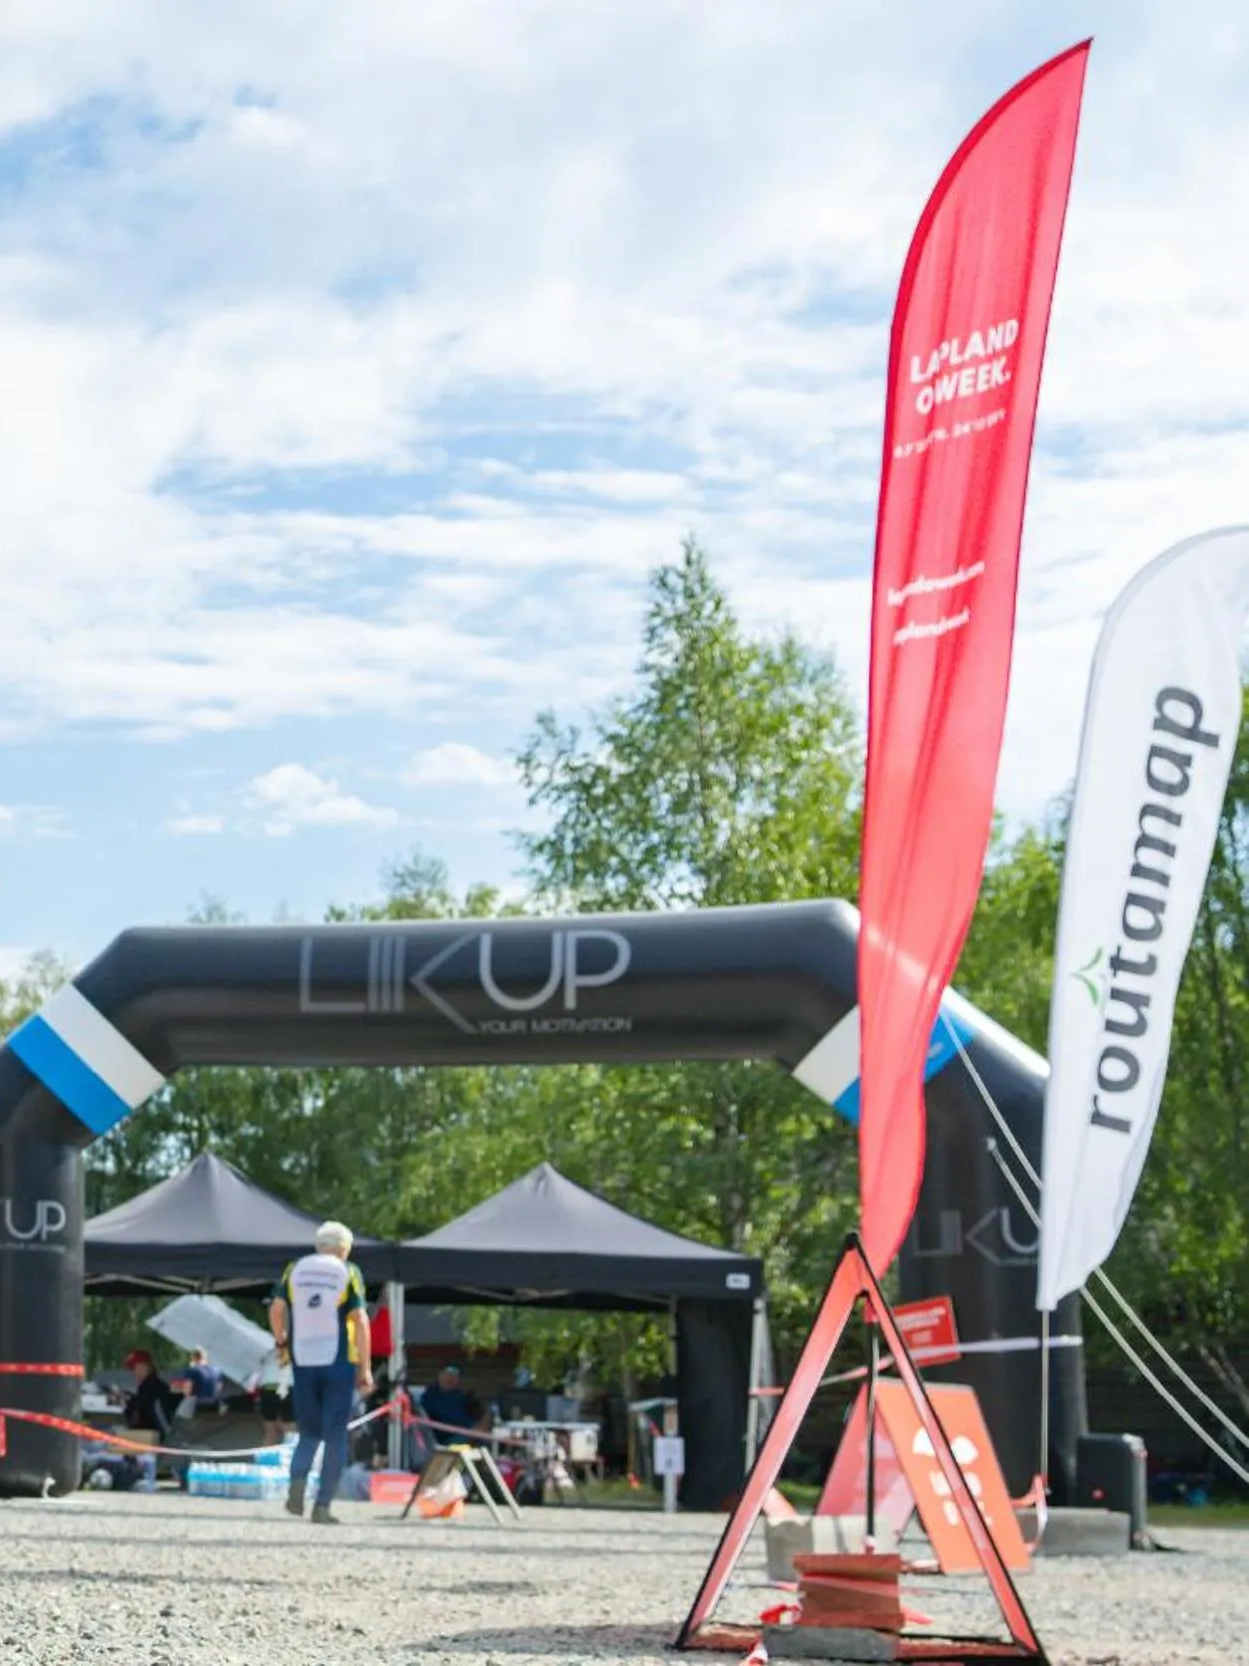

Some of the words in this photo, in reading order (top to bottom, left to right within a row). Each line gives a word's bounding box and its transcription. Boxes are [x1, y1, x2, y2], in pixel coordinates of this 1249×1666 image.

[910, 318, 1019, 384] LAPLAND
[1090, 686, 1220, 1134] routamap
[478, 1019, 528, 1035] YOUR
[531, 1016, 632, 1033] MOTIVATION
